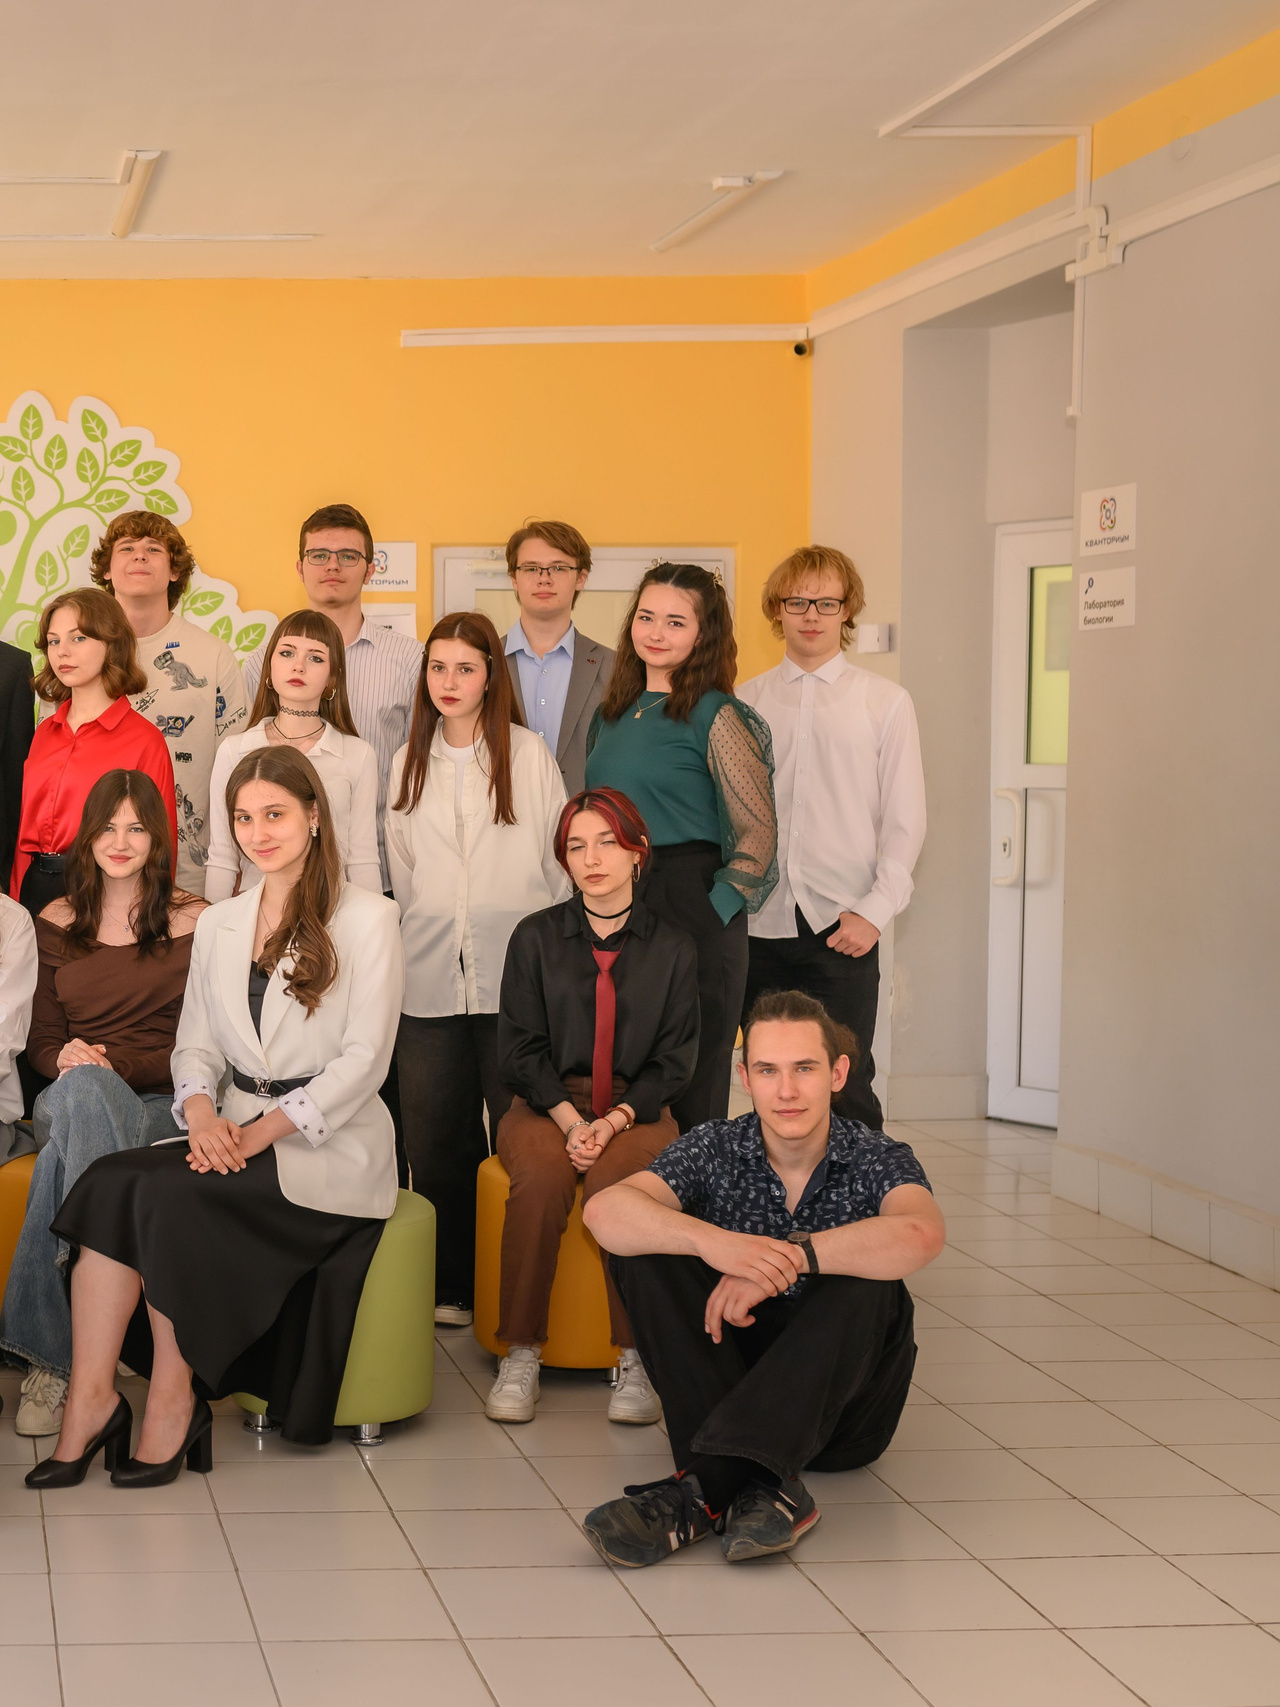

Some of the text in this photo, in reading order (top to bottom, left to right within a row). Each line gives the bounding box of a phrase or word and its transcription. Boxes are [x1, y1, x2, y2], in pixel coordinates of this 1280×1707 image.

[1085, 535, 1130, 548] КВАНТОРИУМ
[1083, 598, 1125, 611] Лаборатория
[1083, 615, 1114, 626] биологии
